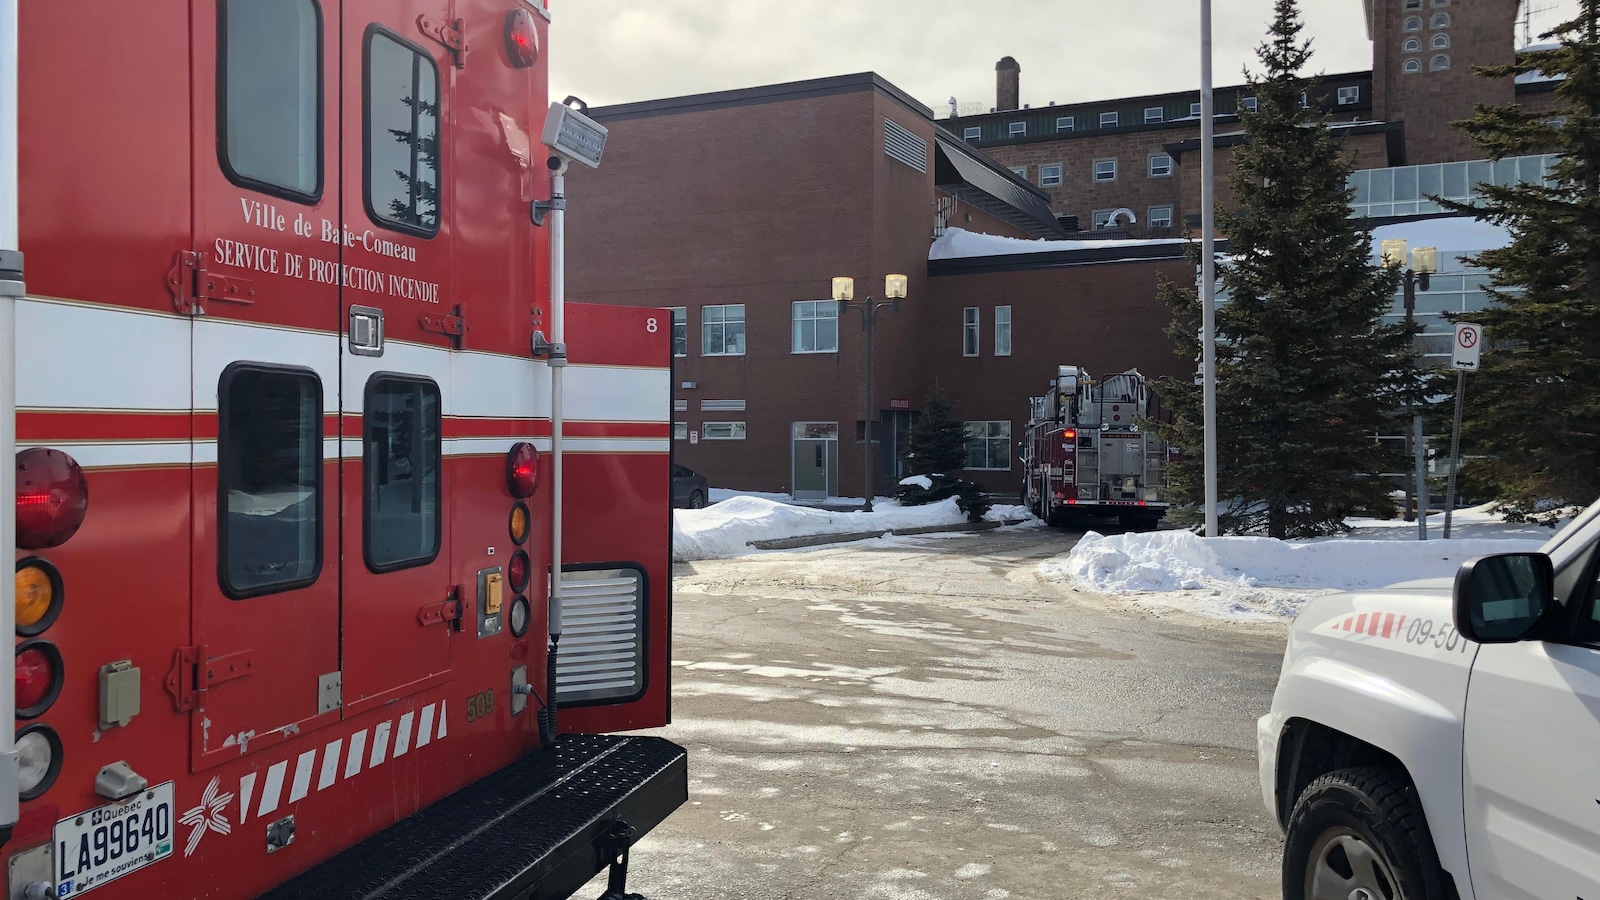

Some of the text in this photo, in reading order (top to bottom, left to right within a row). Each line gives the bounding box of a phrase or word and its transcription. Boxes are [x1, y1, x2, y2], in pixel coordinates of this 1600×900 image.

[240, 198, 417, 262] Ville de Baie-Comeau
[215, 238, 440, 304] SERVICE DE PROTECTION INCENDIE
[646, 317, 658, 333] 8
[466, 688, 494, 723] 509
[60, 802, 169, 881] LA99640
[83, 876, 94, 887] Je
[96, 871, 110, 882] me
[111, 853, 148, 875] souviens
[60, 884, 68, 896] 3
